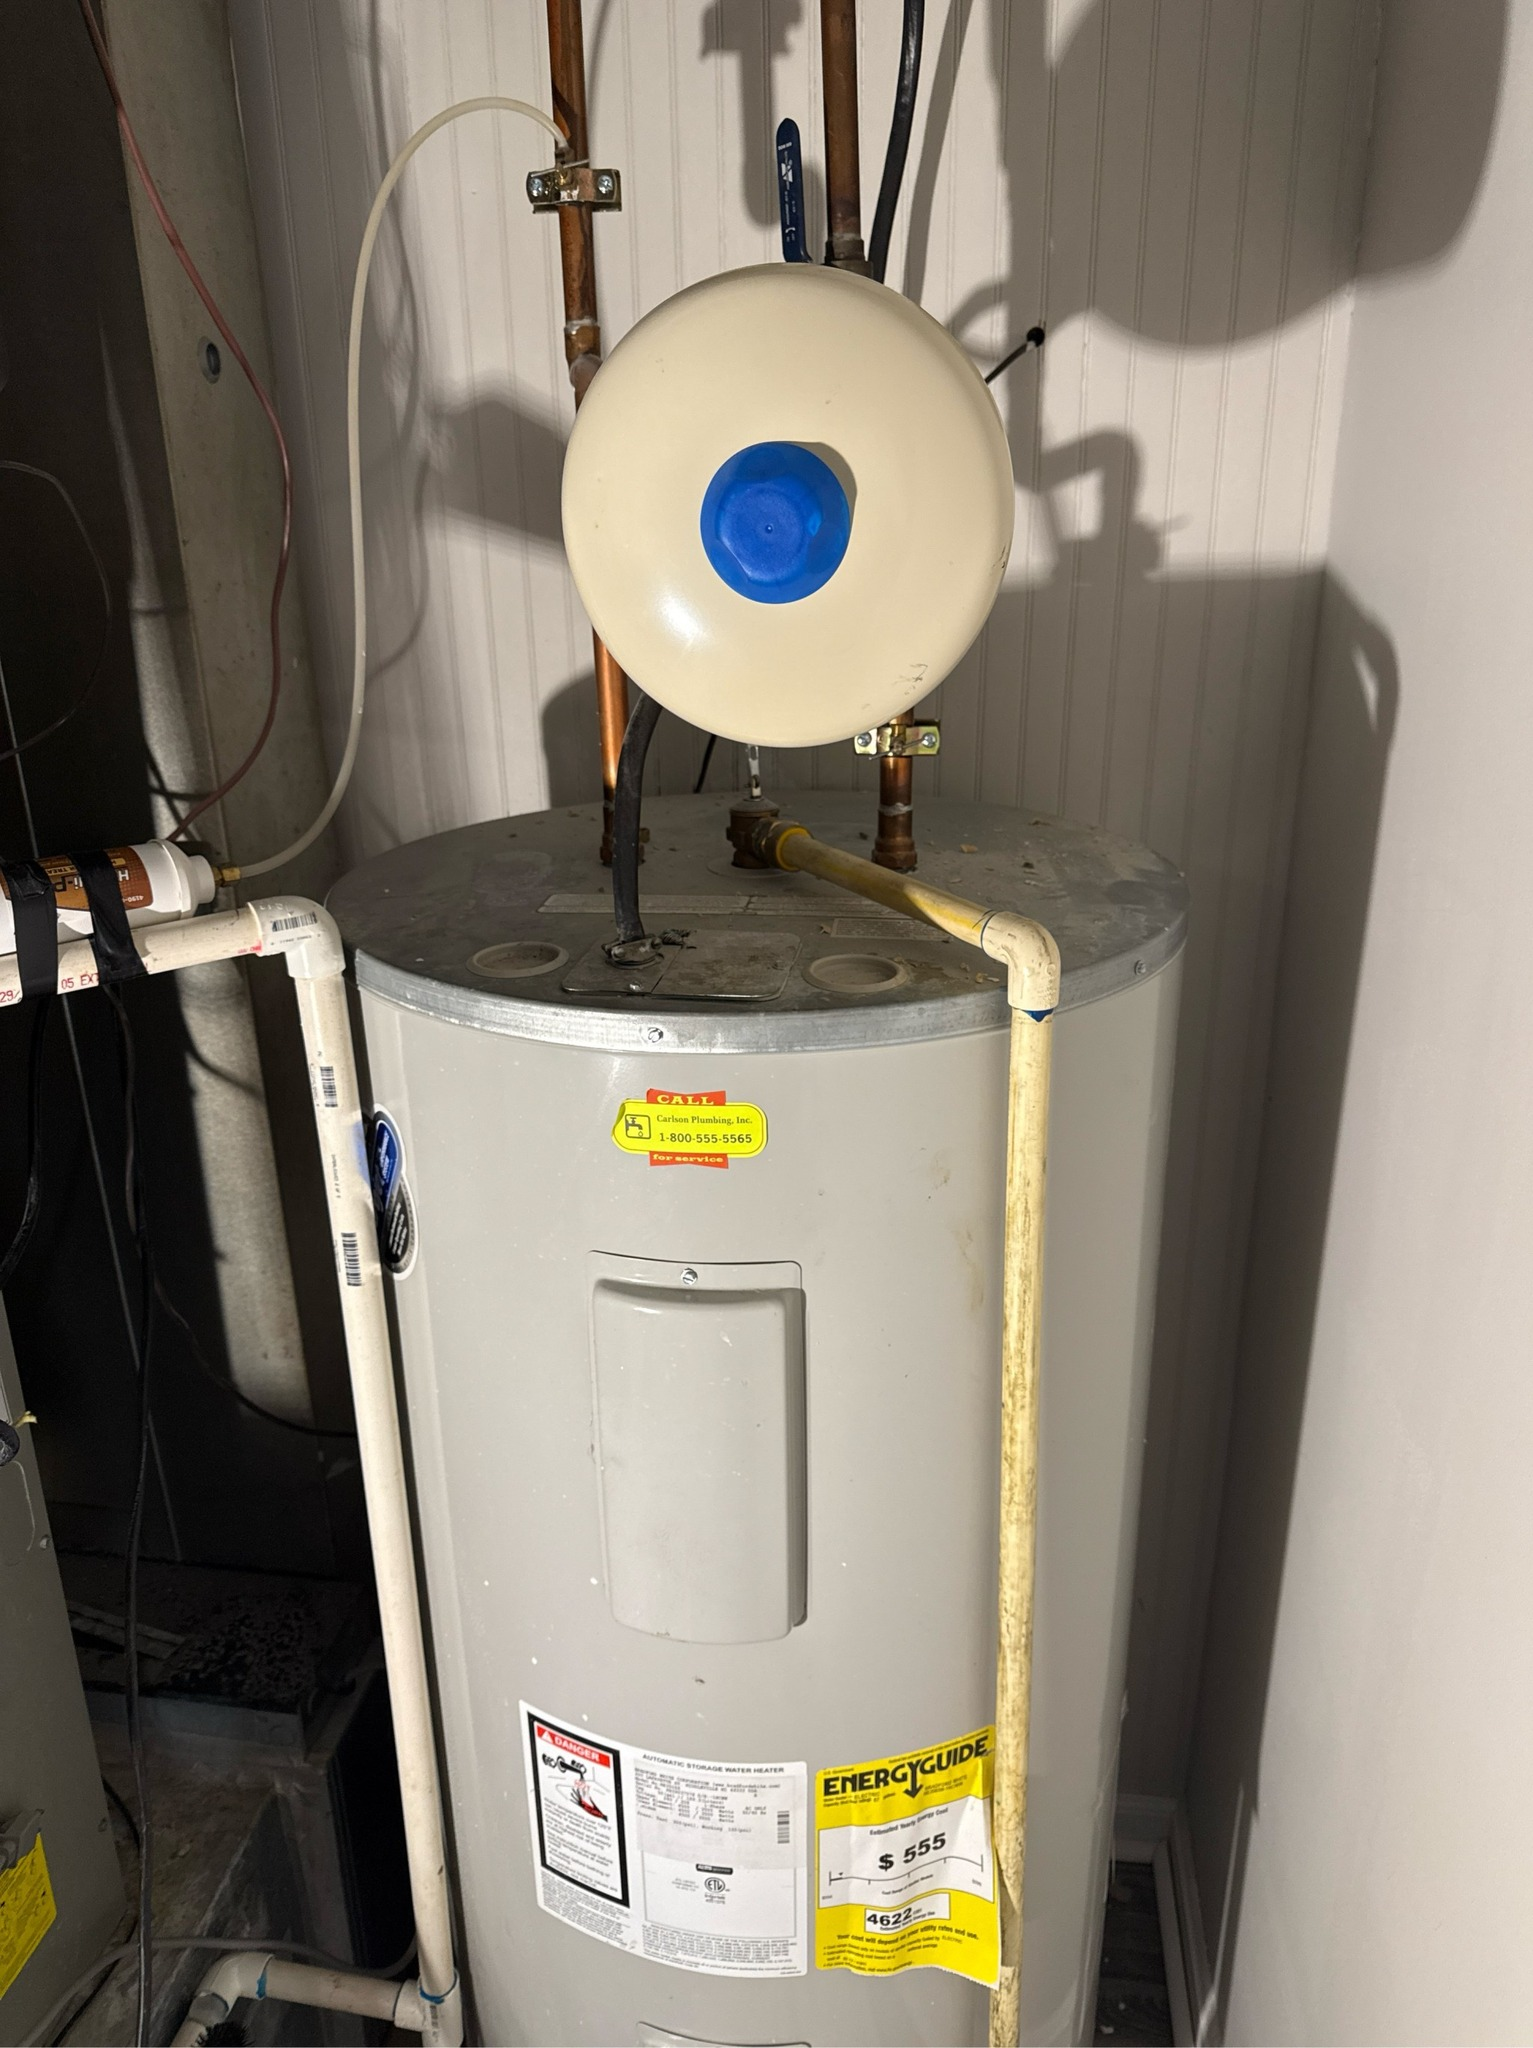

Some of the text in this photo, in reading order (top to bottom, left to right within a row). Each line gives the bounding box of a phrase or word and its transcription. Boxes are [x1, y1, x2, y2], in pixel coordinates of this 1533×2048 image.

[61, 977, 74, 989] 05
[657, 1094, 714, 1105] CALL
[656, 1115, 753, 1125] Carlson Plumbing, Inc.
[659, 1133, 752, 1143] 1-800-555-5565
[554, 1735, 600, 1762] DANGER
[642, 1754, 685, 1768] AUTOMATIC
[687, 1763, 723, 1772] STORAGE
[823, 1735, 989, 1798] ENERGYGUIDE
[869, 1807, 949, 1835] Estimated Yearly Energy Cost
[878, 1832, 946, 1872] $ 555
[707, 1879, 723, 1891] ETL
[866, 1907, 913, 1927] 4622
[907, 1929, 919, 1938] your
[955, 1928, 965, 1936] and
[967, 1932, 979, 1940] use.
